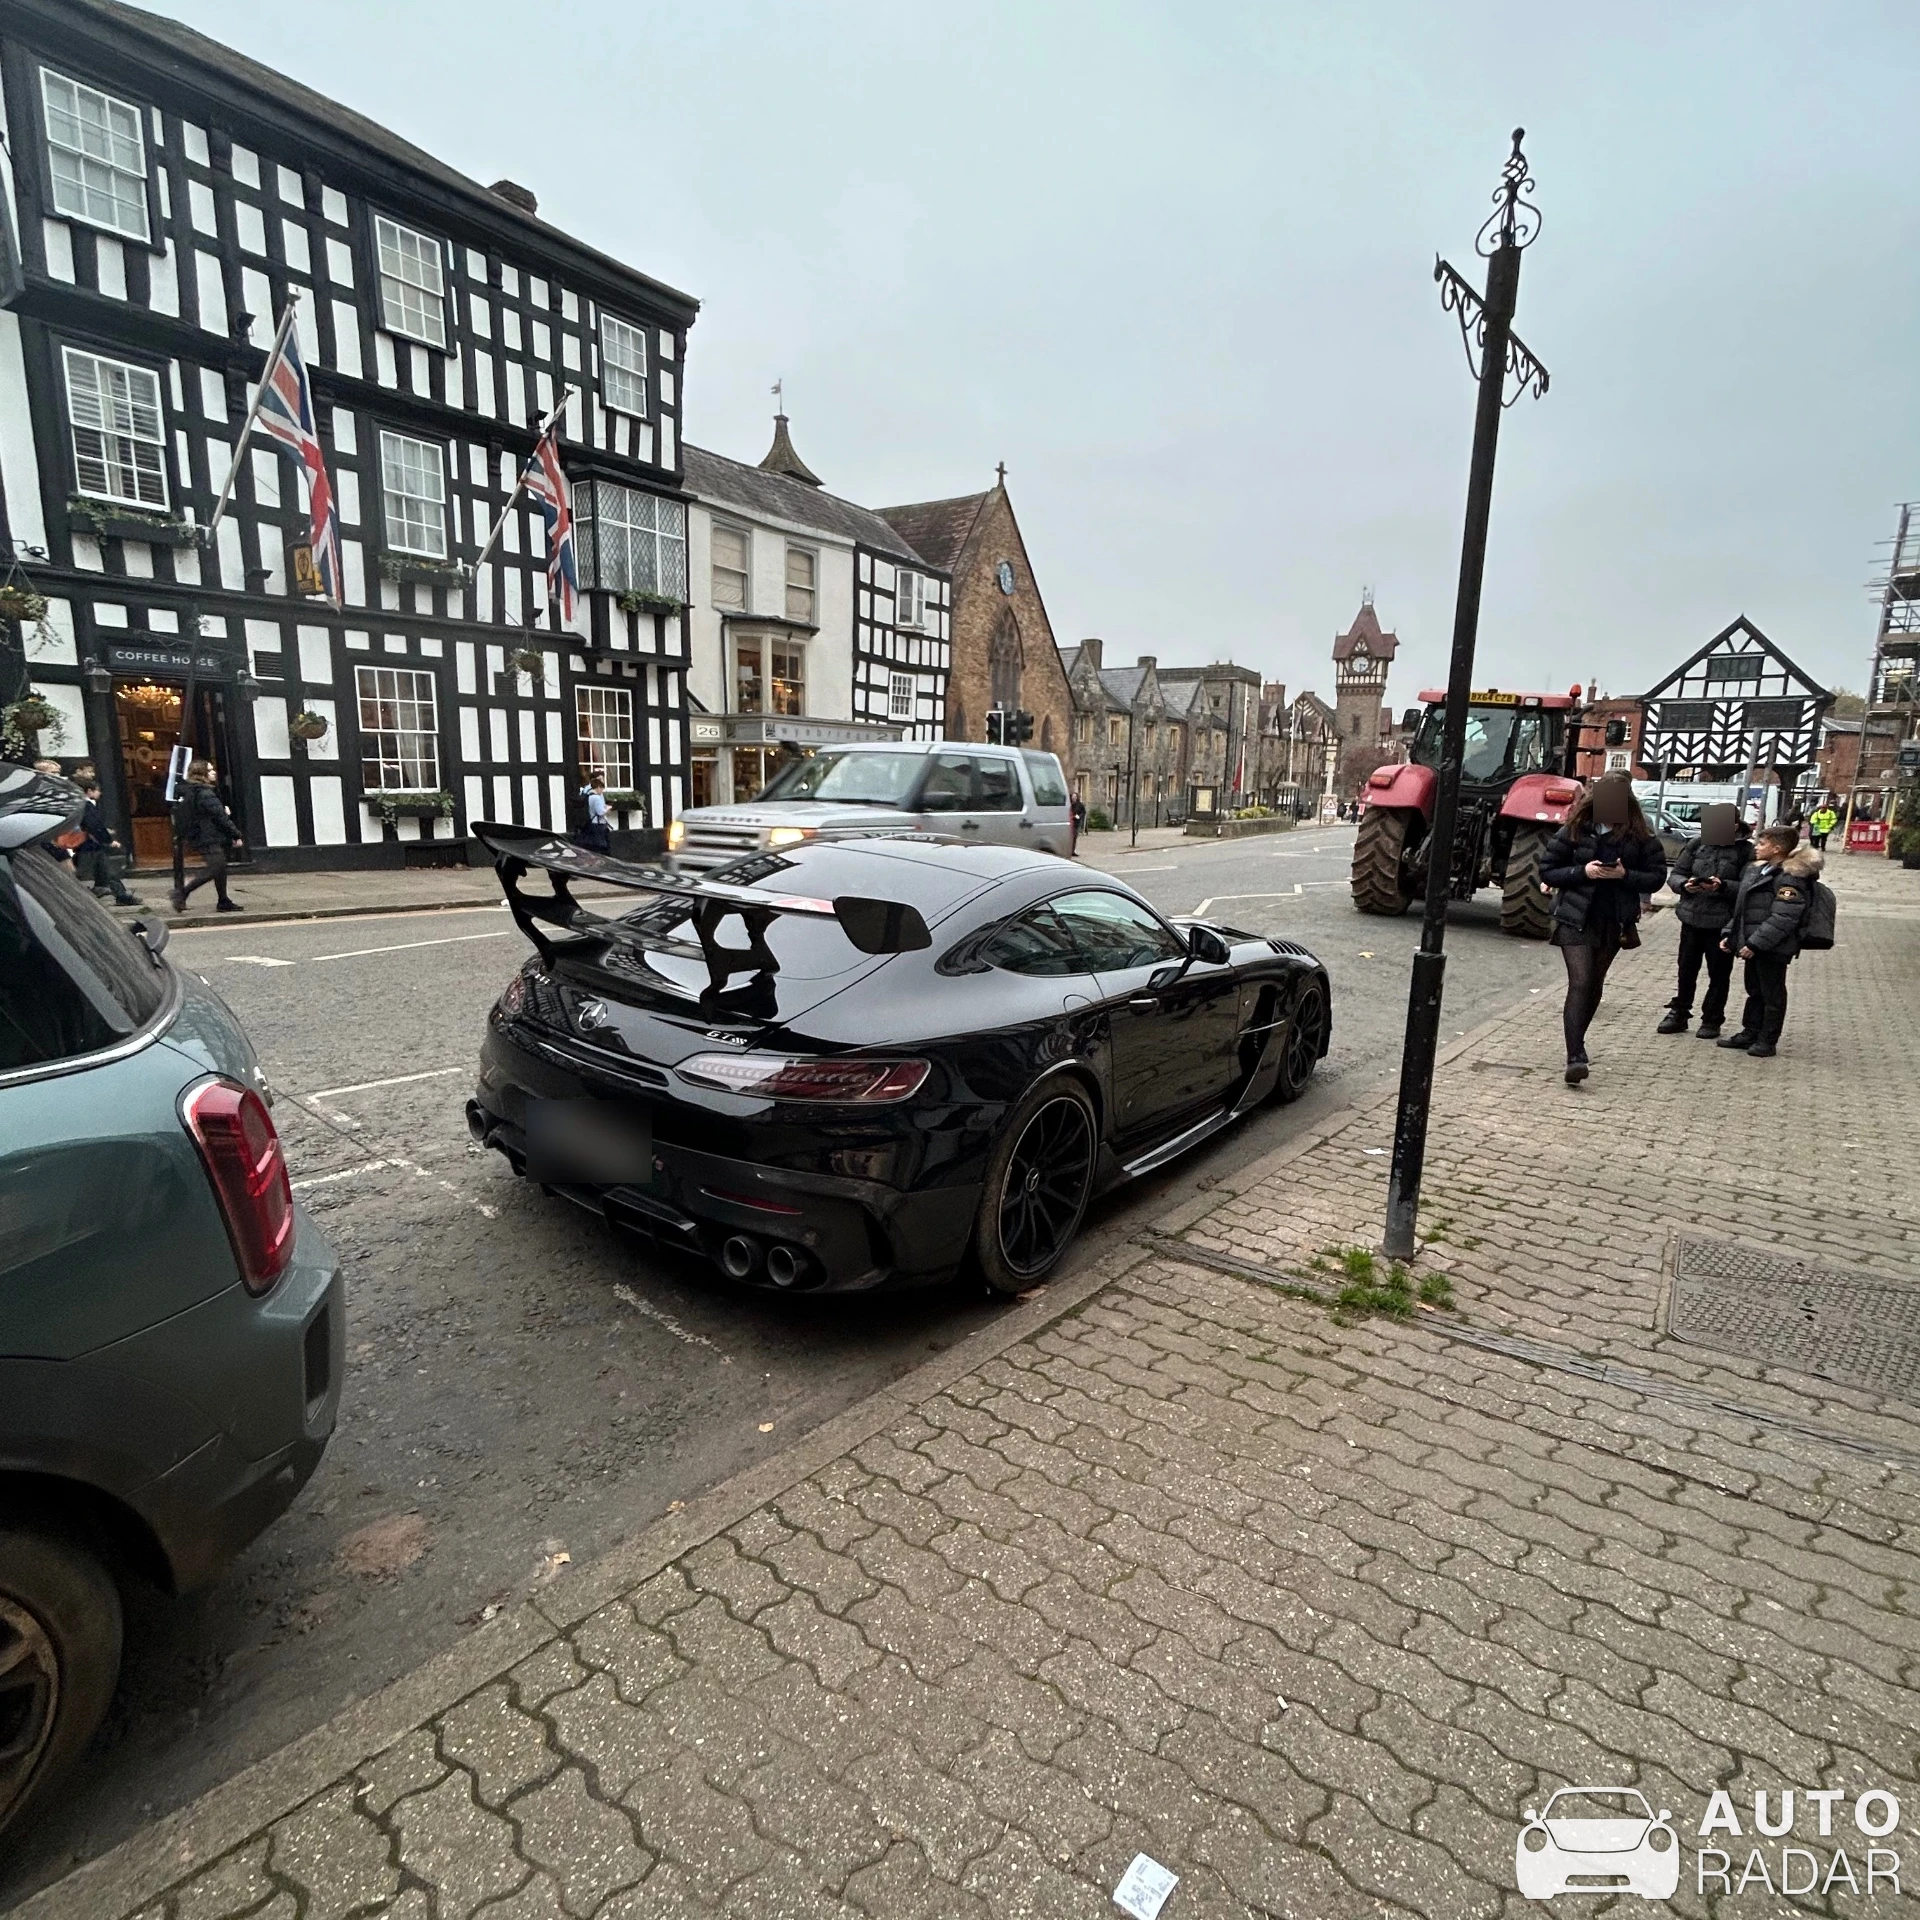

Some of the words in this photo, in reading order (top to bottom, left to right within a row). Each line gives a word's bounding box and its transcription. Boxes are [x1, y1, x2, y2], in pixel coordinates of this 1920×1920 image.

[115, 650, 168, 663] COFFEE
[171, 655, 215, 667] HOSE
[1471, 692, 1493, 701] BX64
[698, 726, 719, 737] 26
